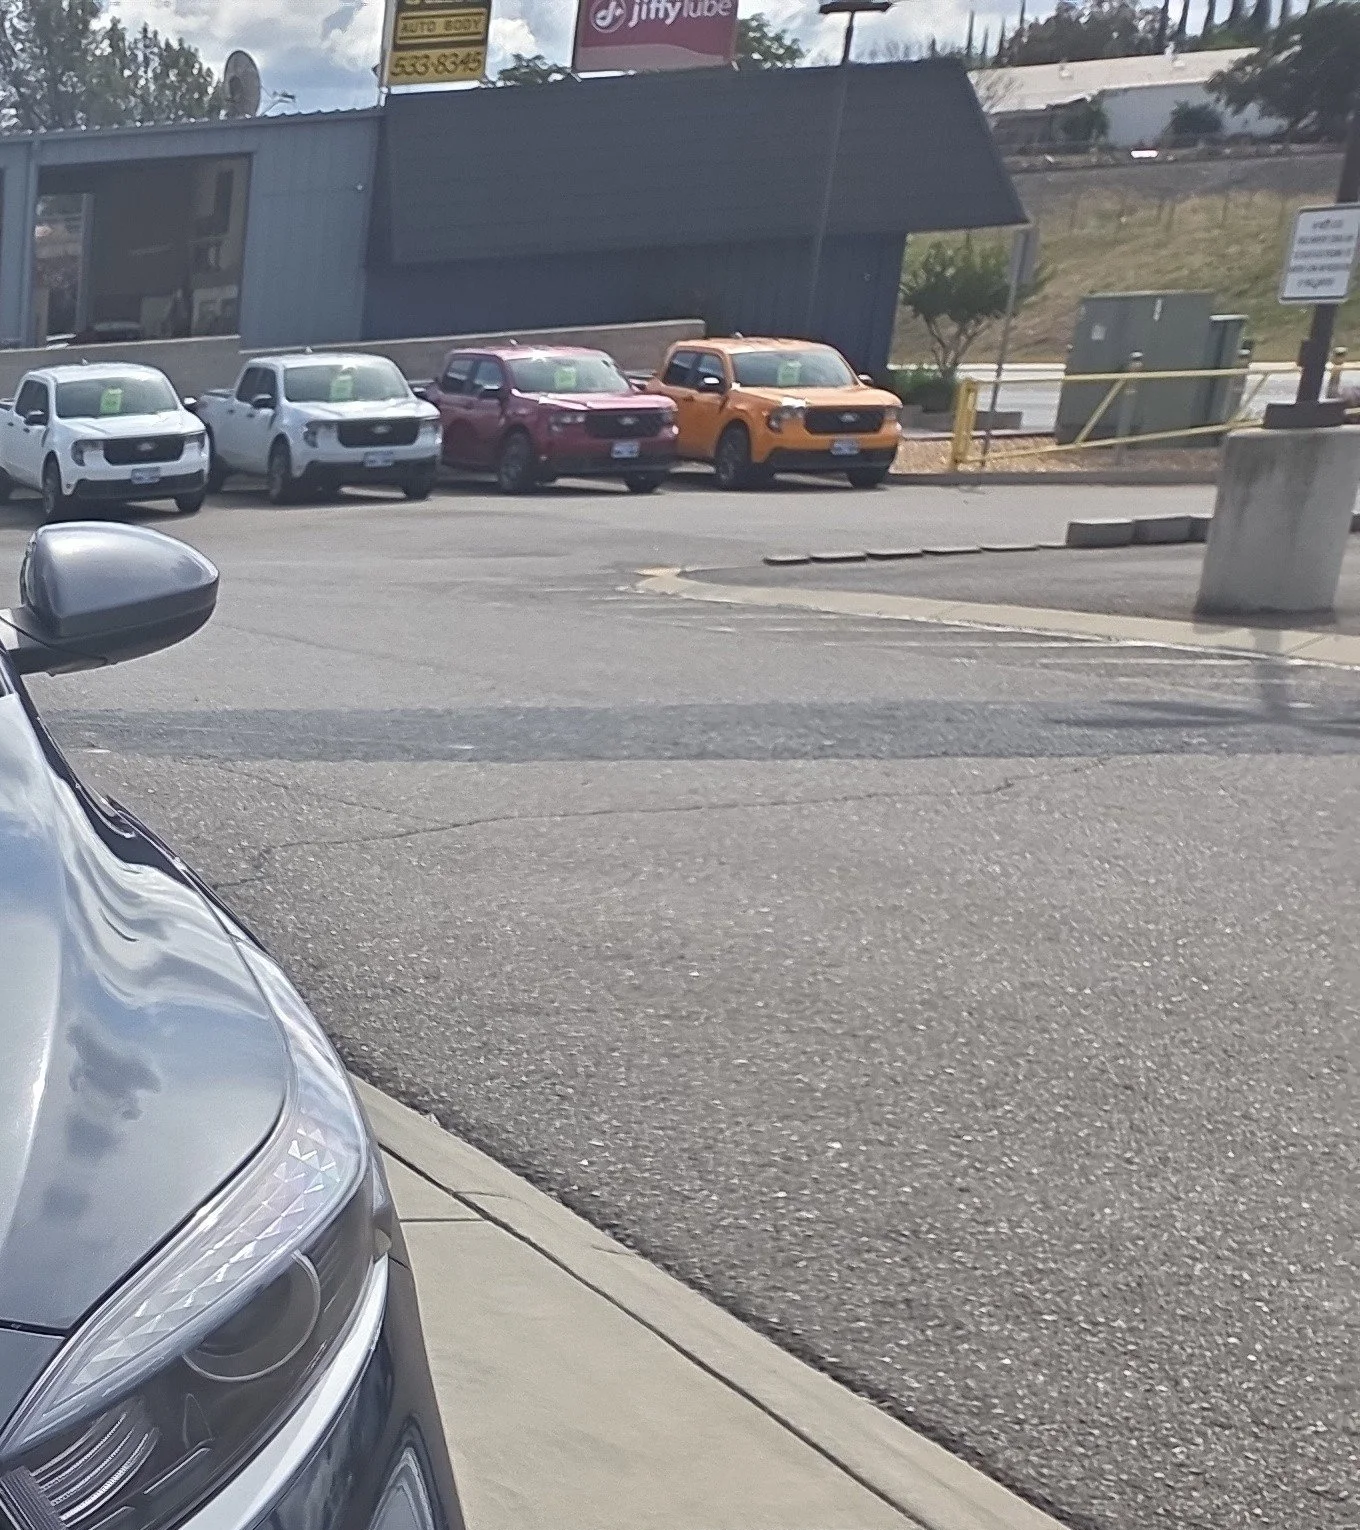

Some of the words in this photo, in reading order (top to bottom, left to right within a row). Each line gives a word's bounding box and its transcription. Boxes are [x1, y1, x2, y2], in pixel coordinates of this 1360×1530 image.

[628, 0, 681, 28] jiffy
[682, 0, 732, 18] lube
[401, 20, 436, 33] AUTO
[444, 18, 481, 31] BODY
